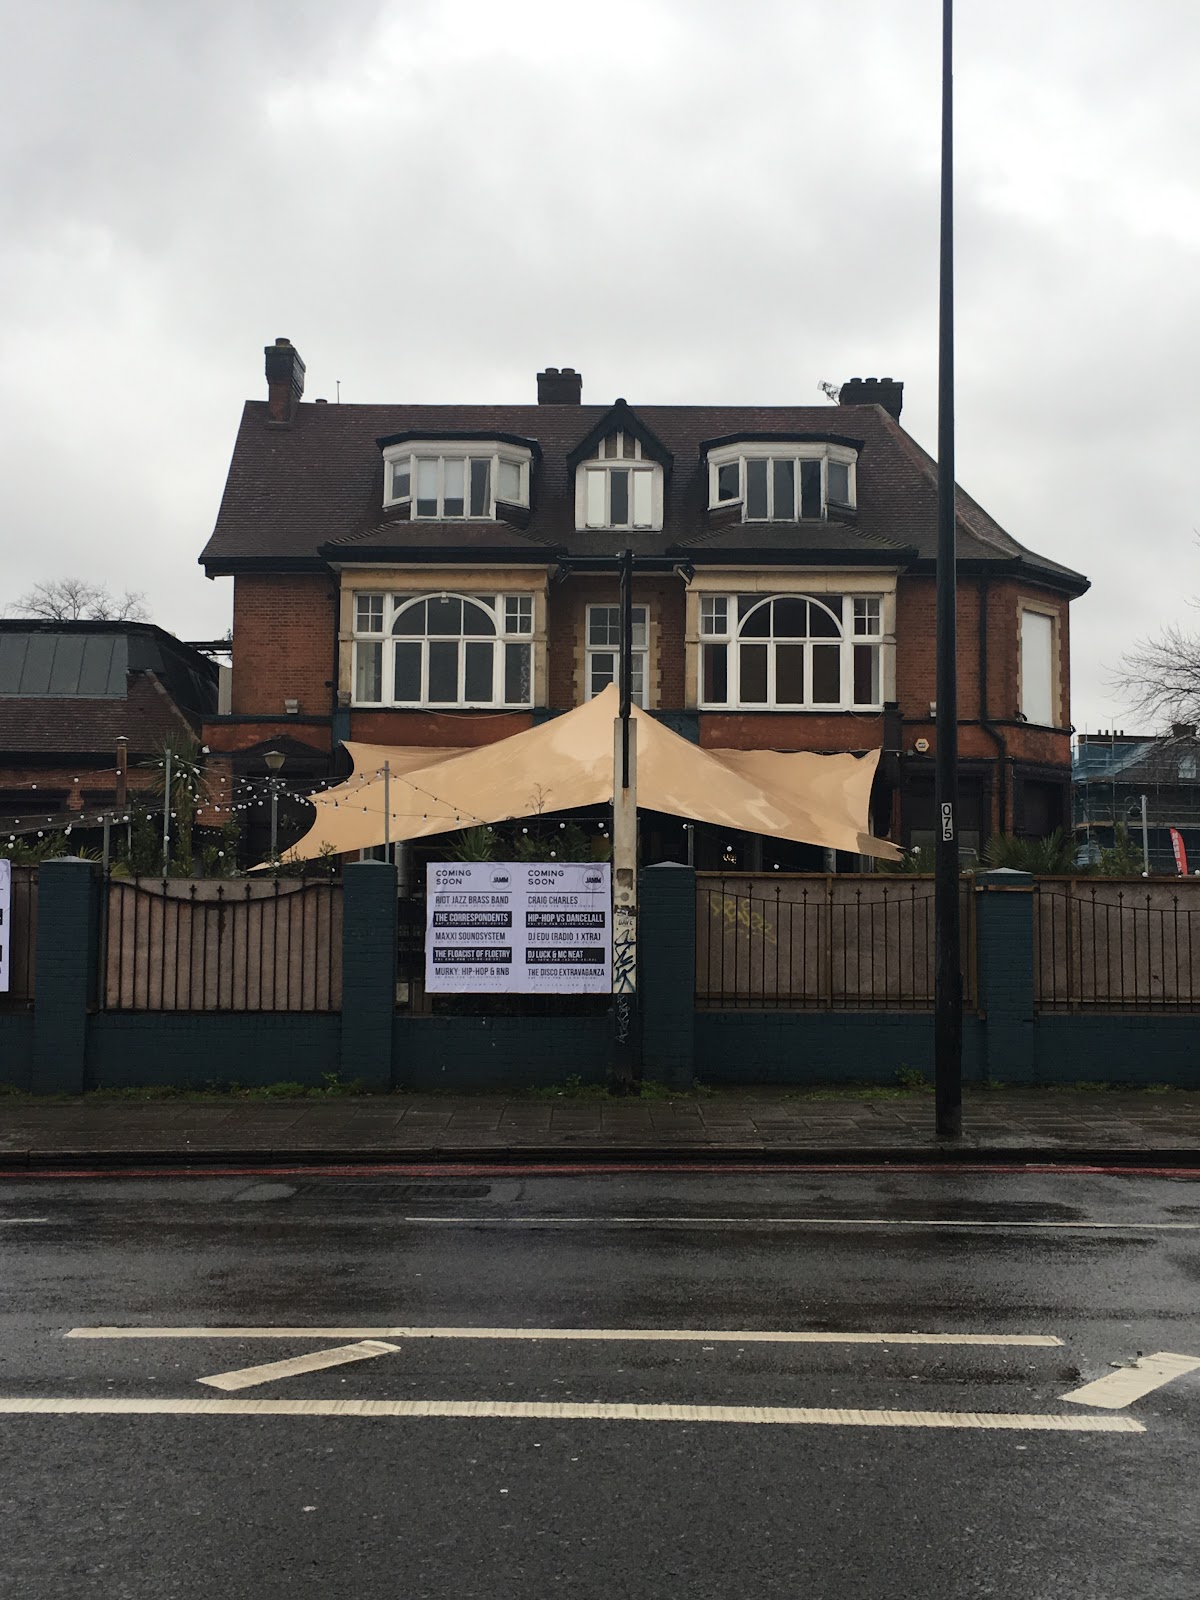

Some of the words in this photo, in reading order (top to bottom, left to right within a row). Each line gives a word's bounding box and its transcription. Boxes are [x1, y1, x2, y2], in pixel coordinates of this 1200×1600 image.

[942, 804, 953, 840] 075
[436, 869, 472, 877] COMING
[527, 869, 565, 877] COMING
[435, 895, 450, 904] RIOT
[451, 895, 467, 904] JAZZ
[468, 895, 490, 904] BRASS
[491, 895, 509, 904] BAND
[527, 896, 548, 905] CRAIG
[549, 896, 579, 905] CHARLES
[435, 913, 448, 922] THE
[449, 913, 509, 922] CORRESPONDENTS
[527, 913, 556, 923] HIP-HOP
[556, 913, 566, 923] VS
[435, 932, 457, 941] MAXXI
[458, 932, 506, 941] SOUNDSYSTEM
[527, 932, 535, 941] DJ
[537, 932, 550, 941] EDU
[435, 949, 447, 958] THE
[447, 949, 475, 958] FLOACIST
[475, 949, 484, 958] OF
[484, 949, 511, 958] FLOETRY
[527, 950, 535, 959] DJ
[536, 950, 551, 959] LUCK
[552, 950, 557, 959] &
[557, 950, 568, 959] MC
[568, 950, 584, 959] NEAT
[461, 967, 489, 976] HIP-HOP
[490, 967, 495, 976] &
[528, 968, 539, 977] THE
[540, 968, 558, 977] DISCO
[559, 968, 605, 977] EXTRAVAGANZA
